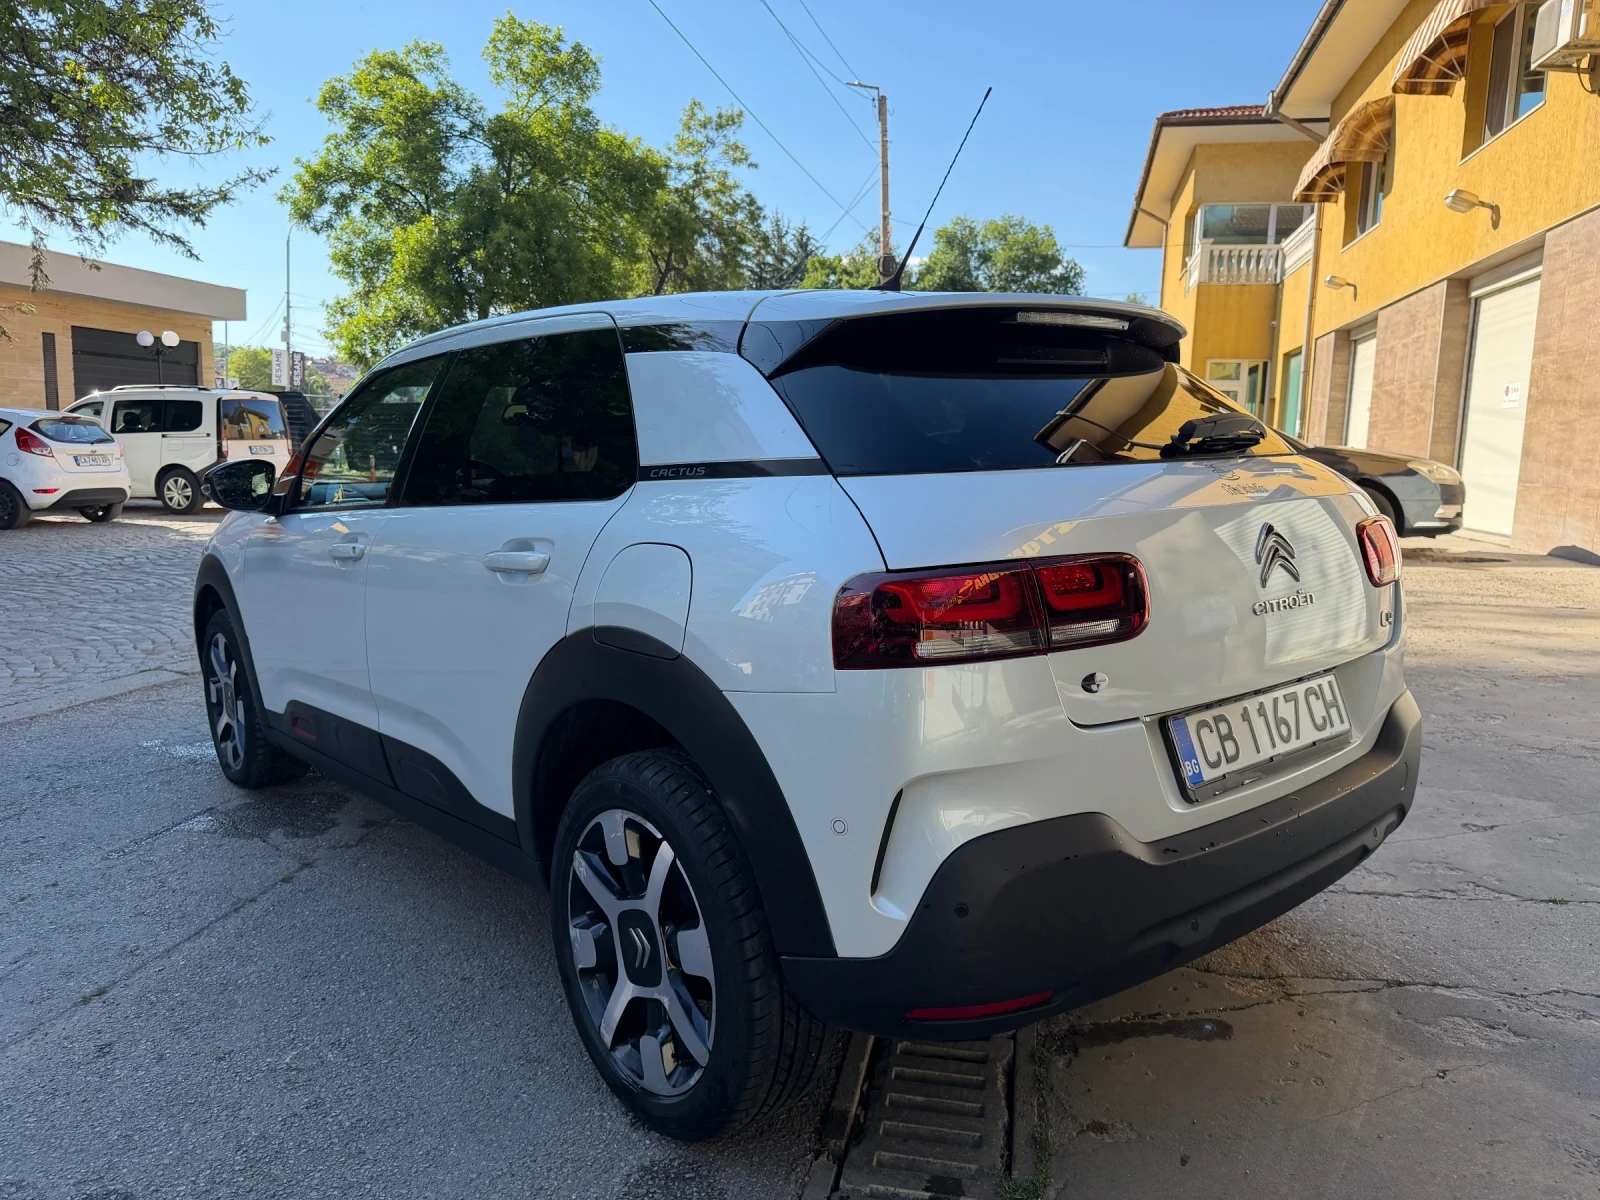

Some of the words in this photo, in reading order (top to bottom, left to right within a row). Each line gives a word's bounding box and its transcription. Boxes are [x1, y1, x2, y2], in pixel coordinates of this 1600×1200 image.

[293, 352, 302, 386] SESAME
[650, 466, 706, 478] CACTUS
[1196, 713, 1240, 769] CB
[1241, 691, 1300, 754] 1167
[1304, 680, 1345, 732] CH
[1184, 760, 1200, 776] BG
